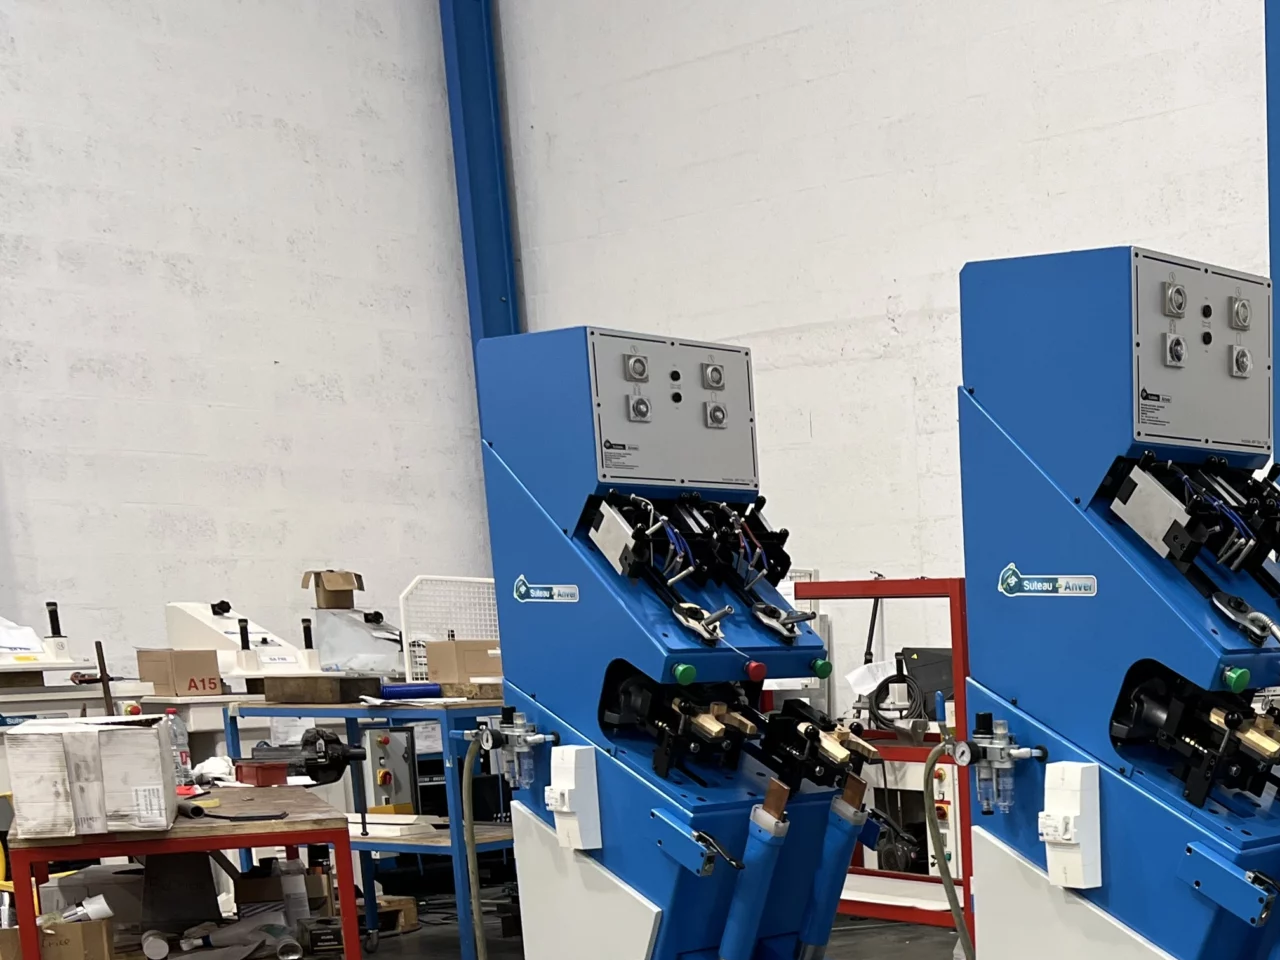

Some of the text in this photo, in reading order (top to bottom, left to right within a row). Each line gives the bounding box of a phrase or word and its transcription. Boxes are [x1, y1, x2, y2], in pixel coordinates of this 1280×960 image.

[1023, 580, 1092, 592] Suteau Anver
[188, 678, 217, 691] A15
